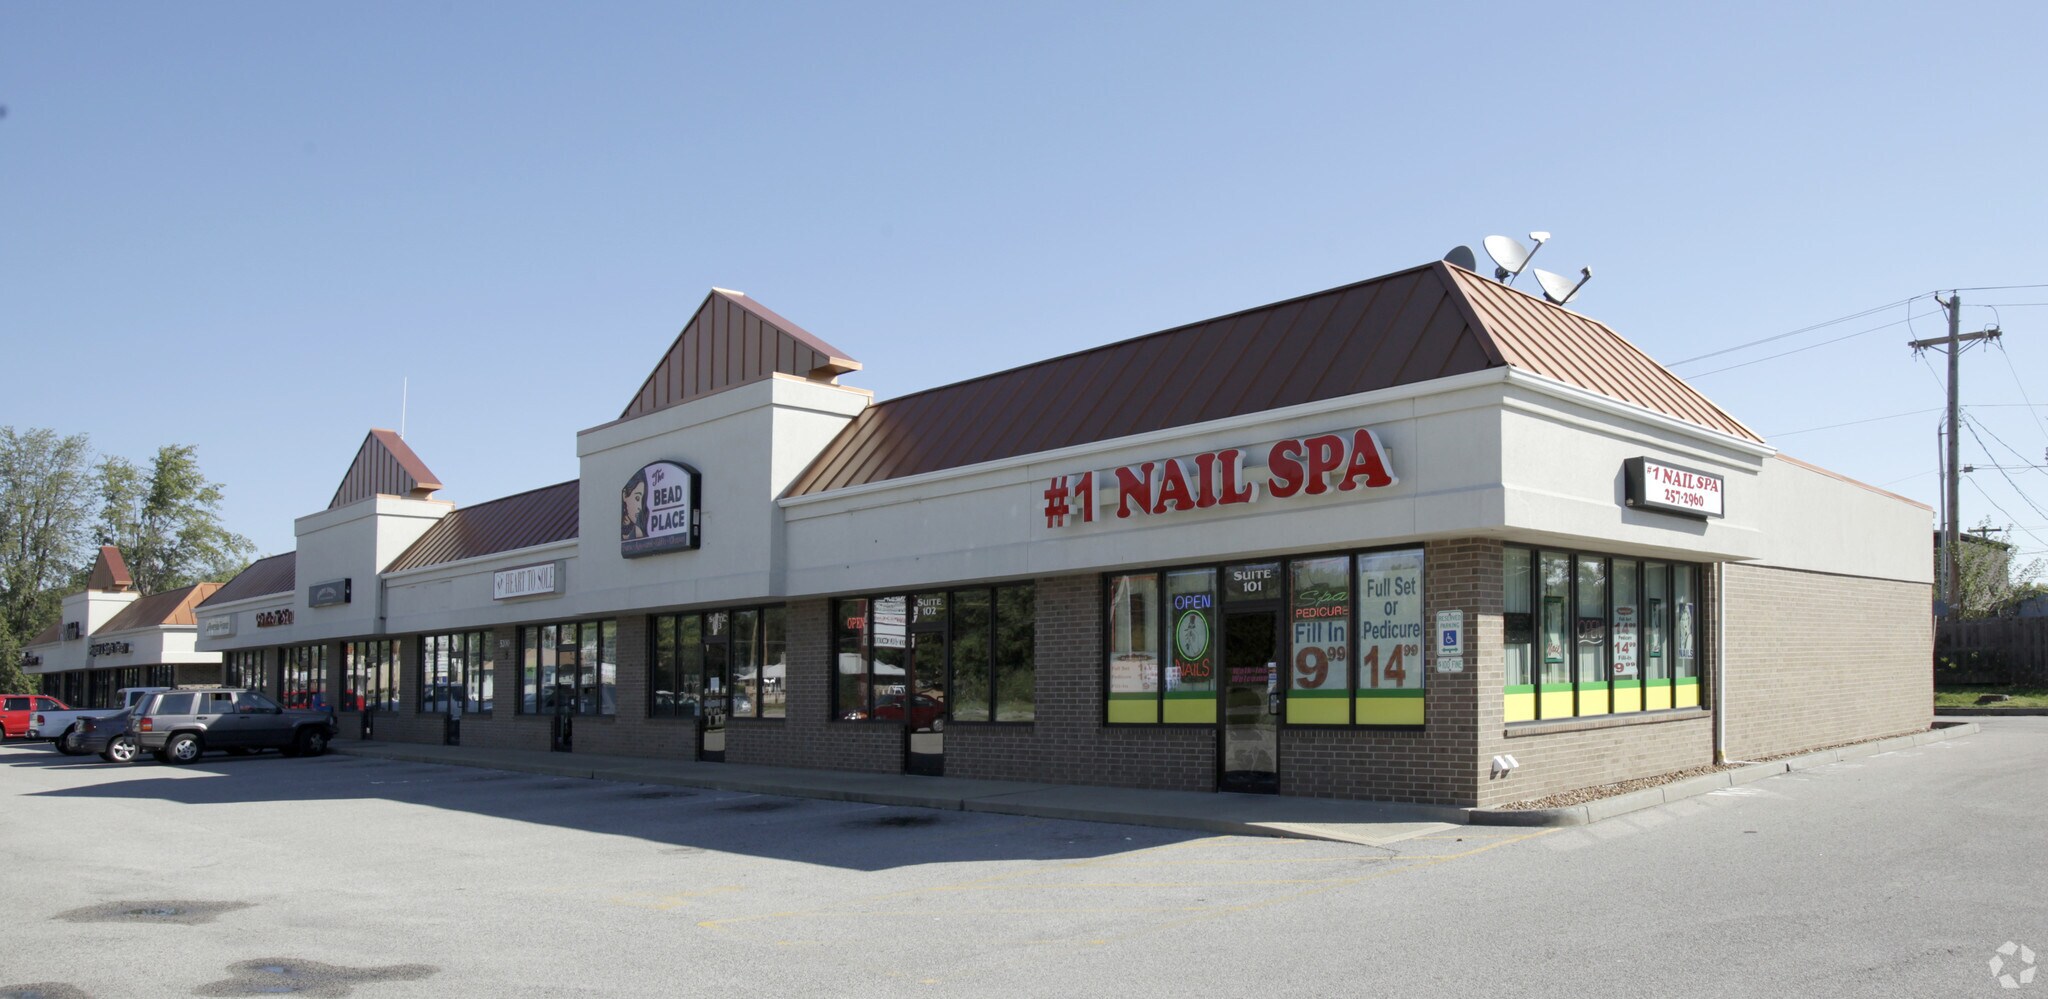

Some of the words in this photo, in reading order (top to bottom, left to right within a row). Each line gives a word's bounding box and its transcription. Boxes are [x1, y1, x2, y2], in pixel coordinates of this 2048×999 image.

[651, 468, 665, 487] The
[1045, 471, 1095, 528] #1
[1115, 449, 1257, 519] NAIL
[1268, 428, 1398, 499] SPA
[1647, 466, 1660, 481] #1
[1662, 468, 1695, 489] NAIL
[1696, 476, 1719, 493] SPA
[653, 485, 683, 507] BEAD
[651, 510, 685, 532] PLACE
[505, 571, 526, 594] HEART
[527, 569, 537, 591] TO
[537, 566, 554, 590] SOLE
[1233, 569, 1272, 581] SUITE
[1243, 581, 1262, 592] 101
[1367, 578, 1390, 598] Full
[1394, 576, 1416, 596] Set
[917, 598, 942, 607] SUITE
[1175, 595, 1211, 610] OPEN
[1297, 590, 1349, 606] Spa
[922, 606, 937, 616] 102
[1295, 605, 1349, 618] PEDICURE
[1384, 600, 1398, 616] or
[847, 617, 865, 630] OPEN
[1295, 621, 1322, 644] Fill
[1328, 621, 1345, 642] In
[1363, 620, 1420, 640] Pedicure
[1175, 658, 1211, 677] NAILS
